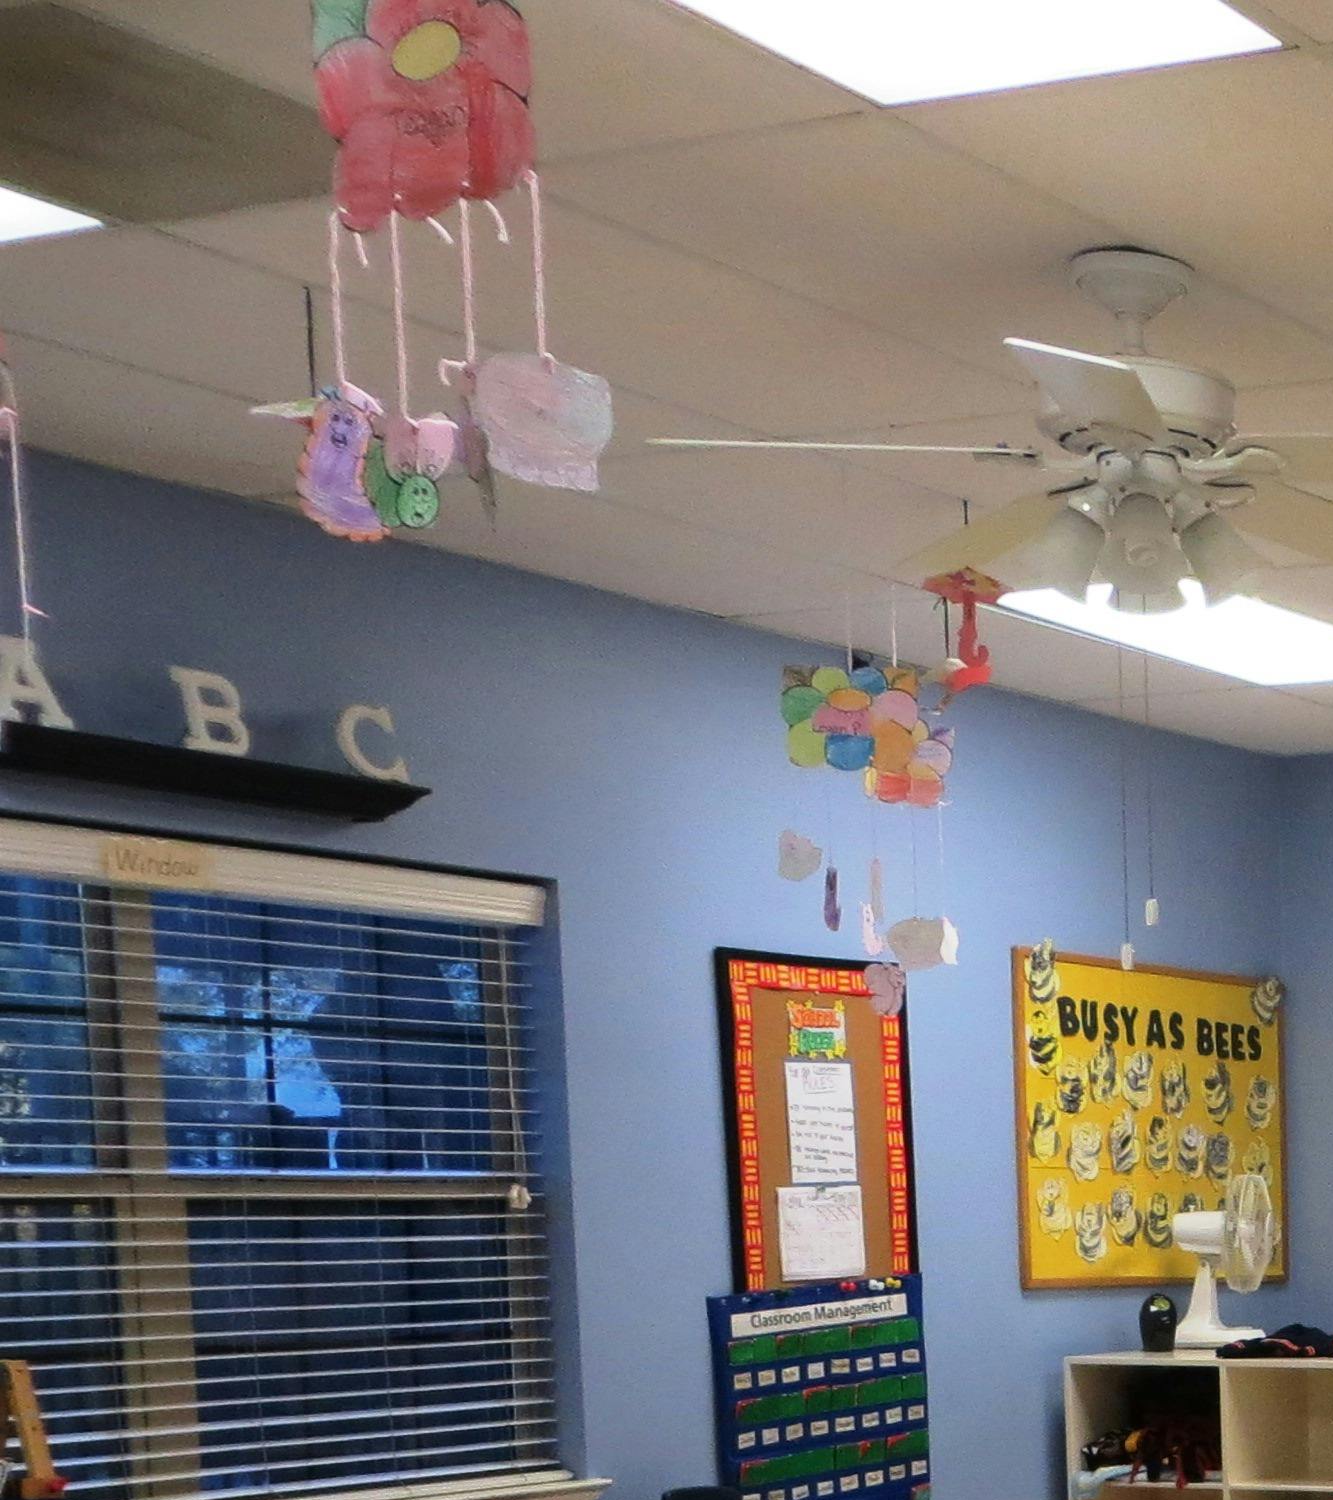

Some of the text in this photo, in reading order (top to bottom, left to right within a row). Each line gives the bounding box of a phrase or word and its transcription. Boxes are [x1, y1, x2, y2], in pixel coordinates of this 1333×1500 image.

[0, 636, 410, 783] A B C
[115, 847, 200, 879] Window
[1057, 996, 1262, 1062] BUSY AS BEES
[749, 1299, 894, 1329] Classroom Management
